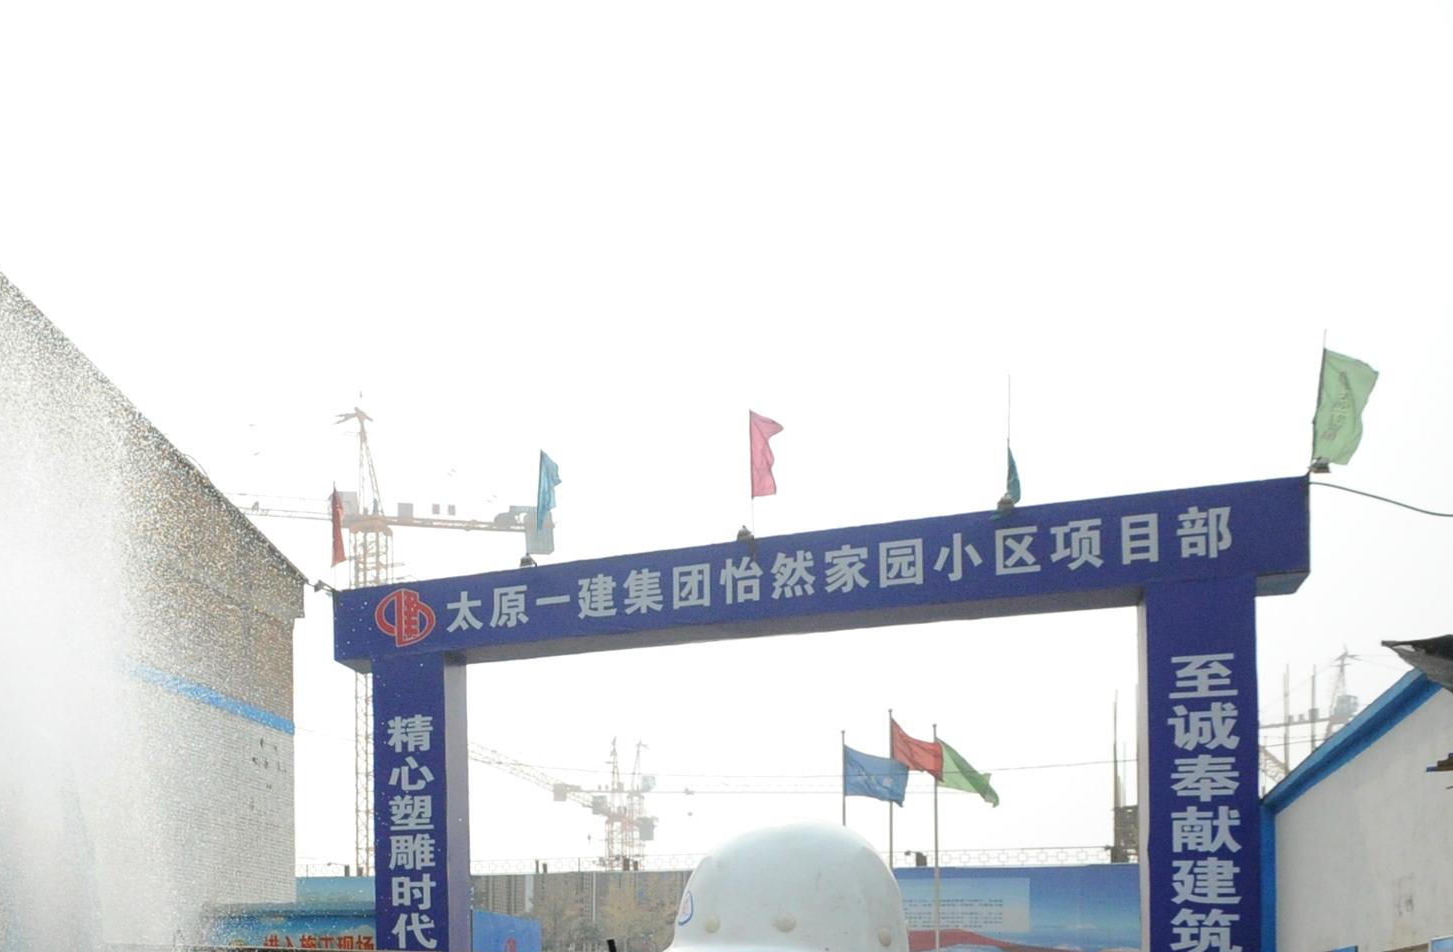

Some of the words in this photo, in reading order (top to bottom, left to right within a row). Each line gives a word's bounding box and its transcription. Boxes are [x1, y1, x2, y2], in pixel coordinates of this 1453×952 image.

[447, 506, 1234, 632] 太原一建集团怡然家园小区项目部
[387, 713, 438, 950] 精心塑雕时代
